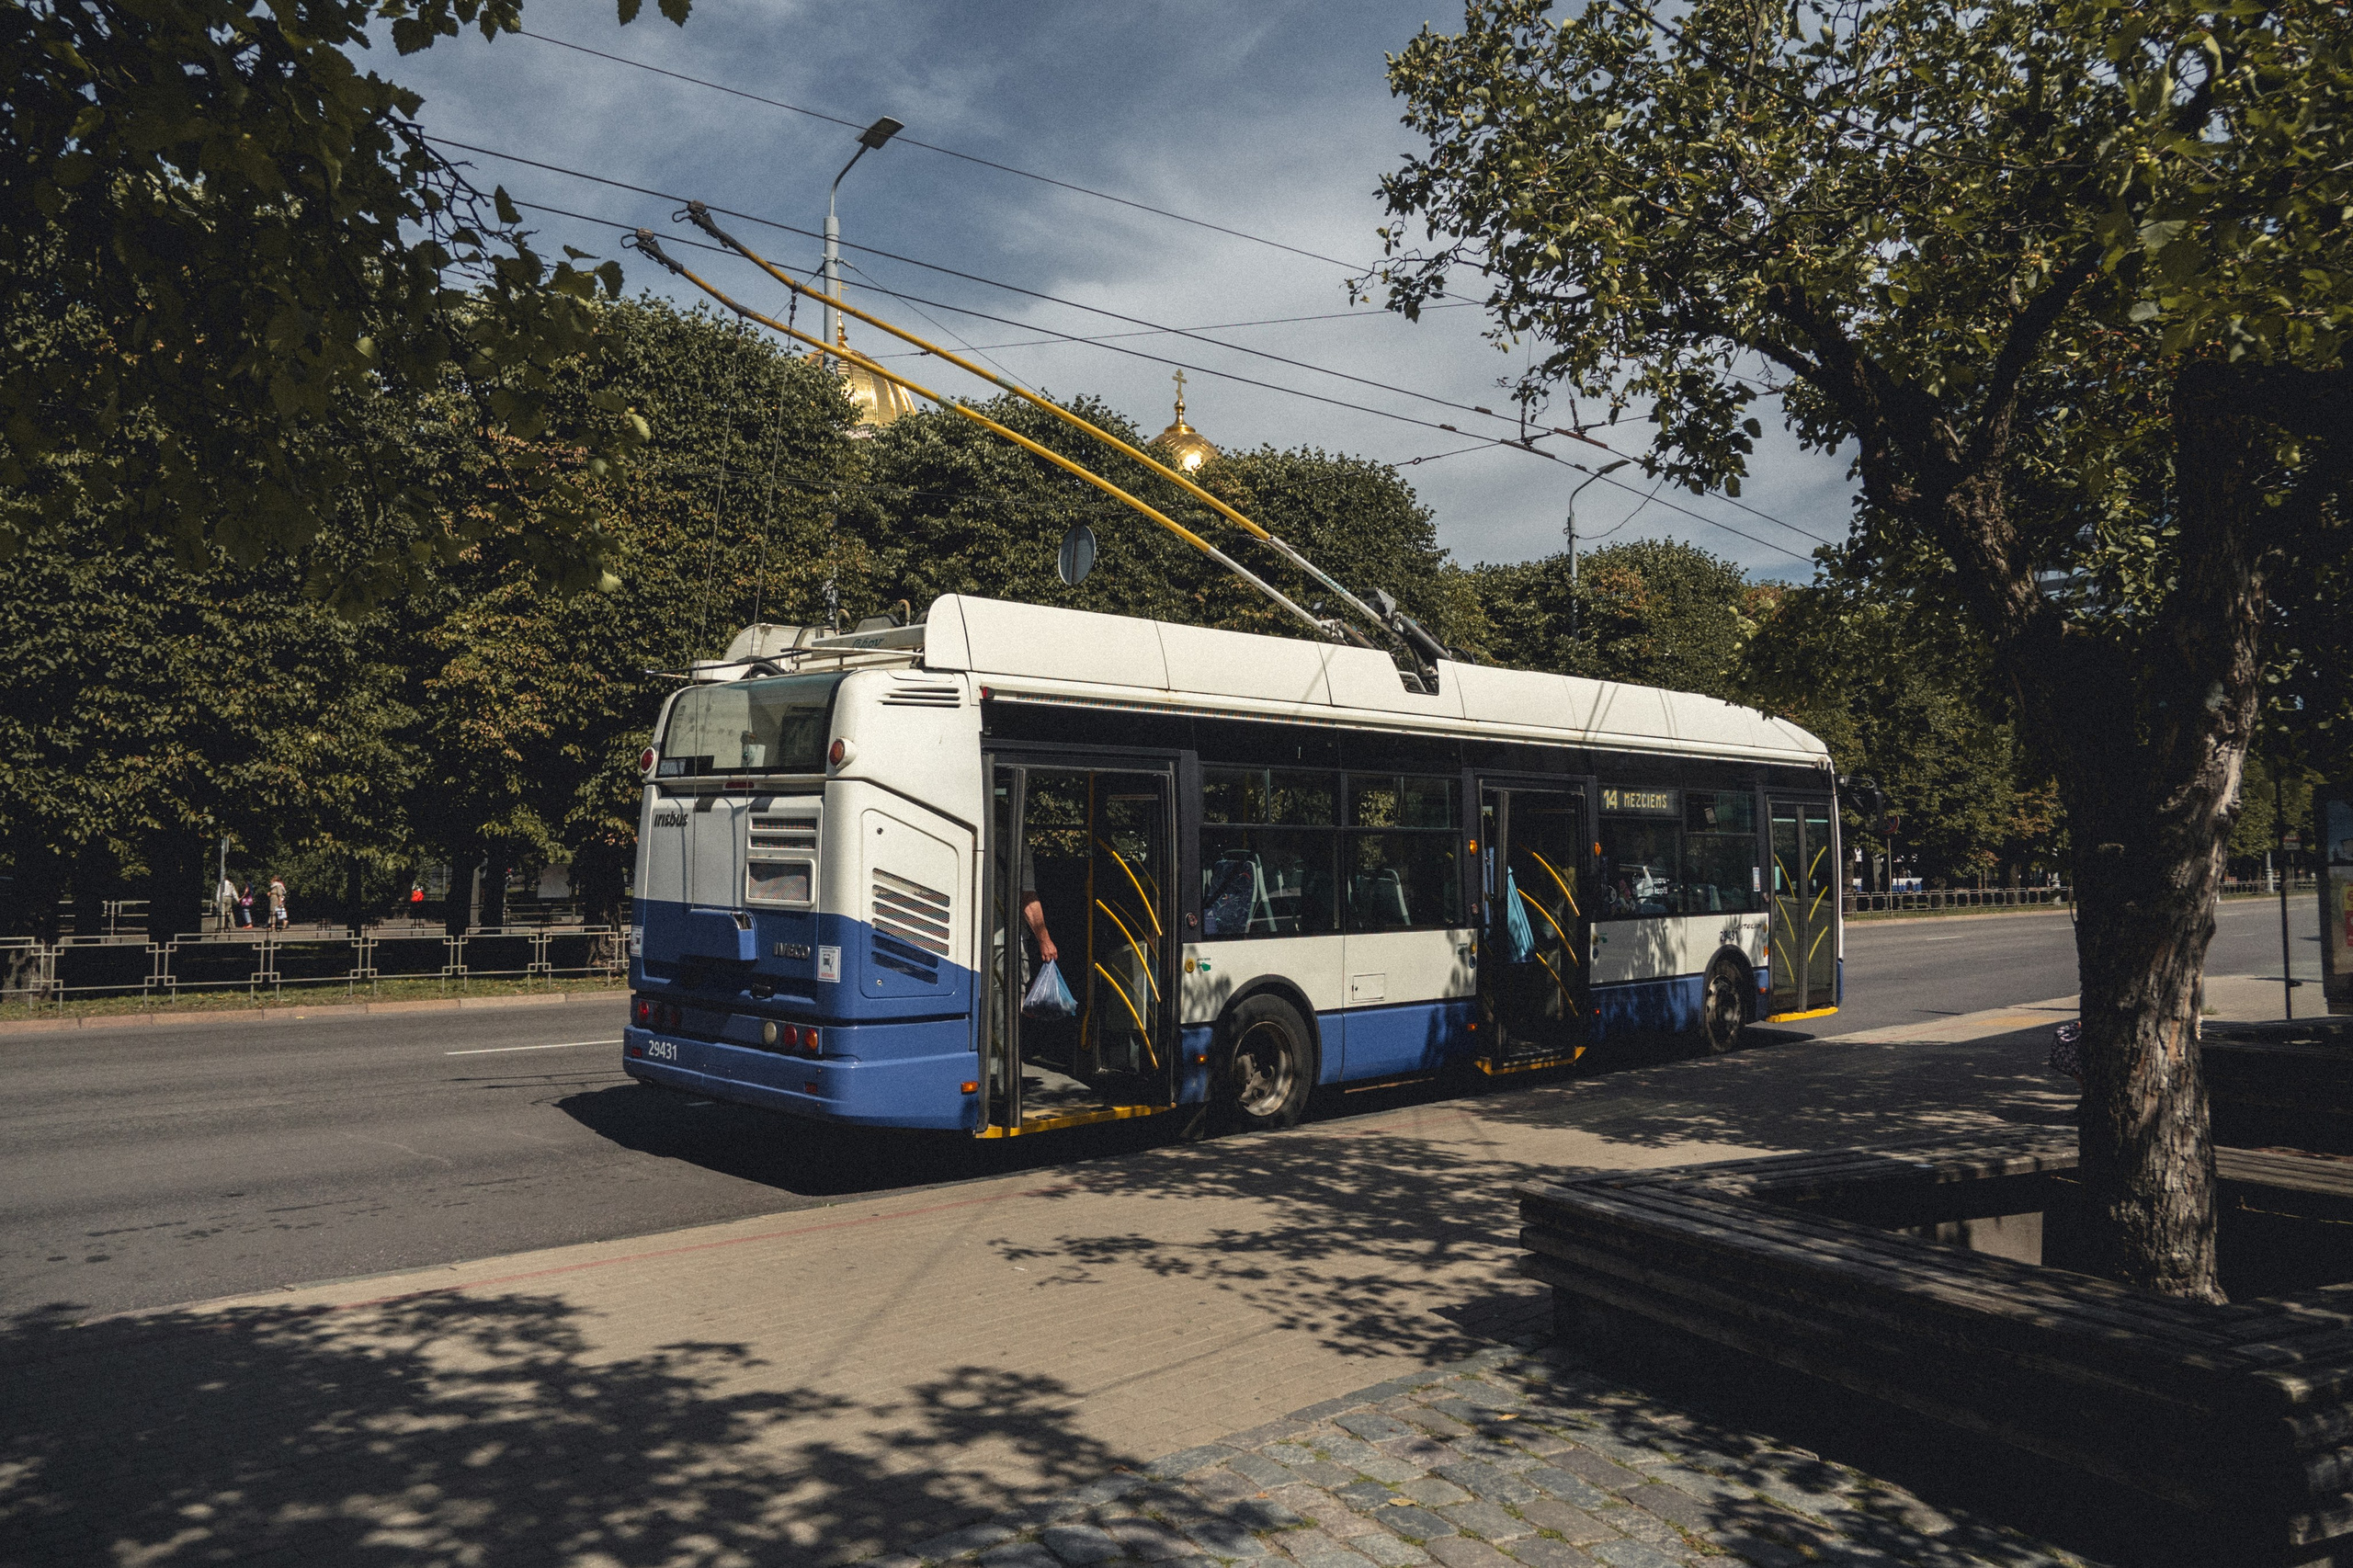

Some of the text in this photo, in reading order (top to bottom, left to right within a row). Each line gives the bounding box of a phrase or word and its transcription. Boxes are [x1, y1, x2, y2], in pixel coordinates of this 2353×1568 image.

[1603, 790, 1667, 809] 14 MEZCIEMS
[1720, 929, 1738, 942] 29431
[774, 942, 811, 960] IVECO
[648, 1040, 677, 1061] 29431
